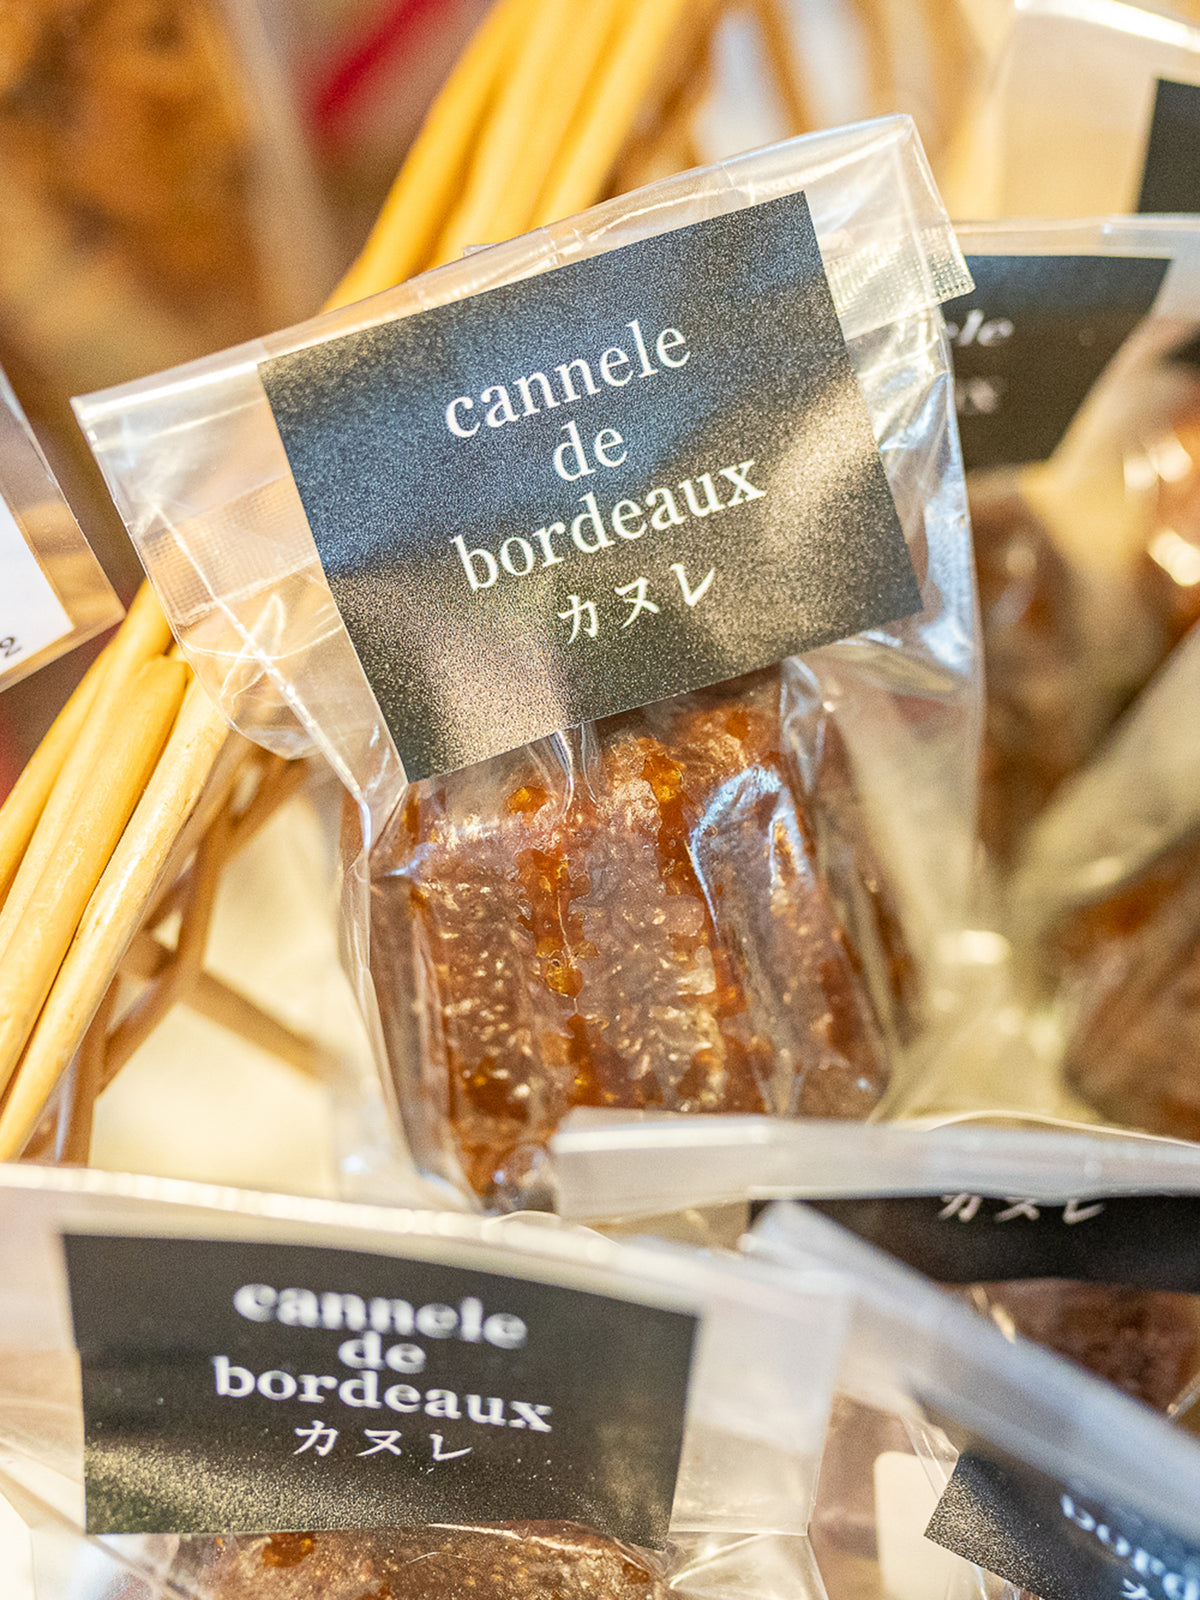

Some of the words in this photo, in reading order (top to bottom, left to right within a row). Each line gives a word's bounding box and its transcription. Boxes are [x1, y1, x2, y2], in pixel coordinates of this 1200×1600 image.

[445, 319, 691, 438] cannele
[553, 420, 627, 481] de
[450, 460, 766, 591] bordeaux
[557, 563, 715, 644] カヌレ
[233, 1283, 528, 1349] cannele
[338, 1331, 426, 1374] de
[213, 1355, 552, 1432] bordeaux
[293, 1420, 473, 1461] カヌレ
